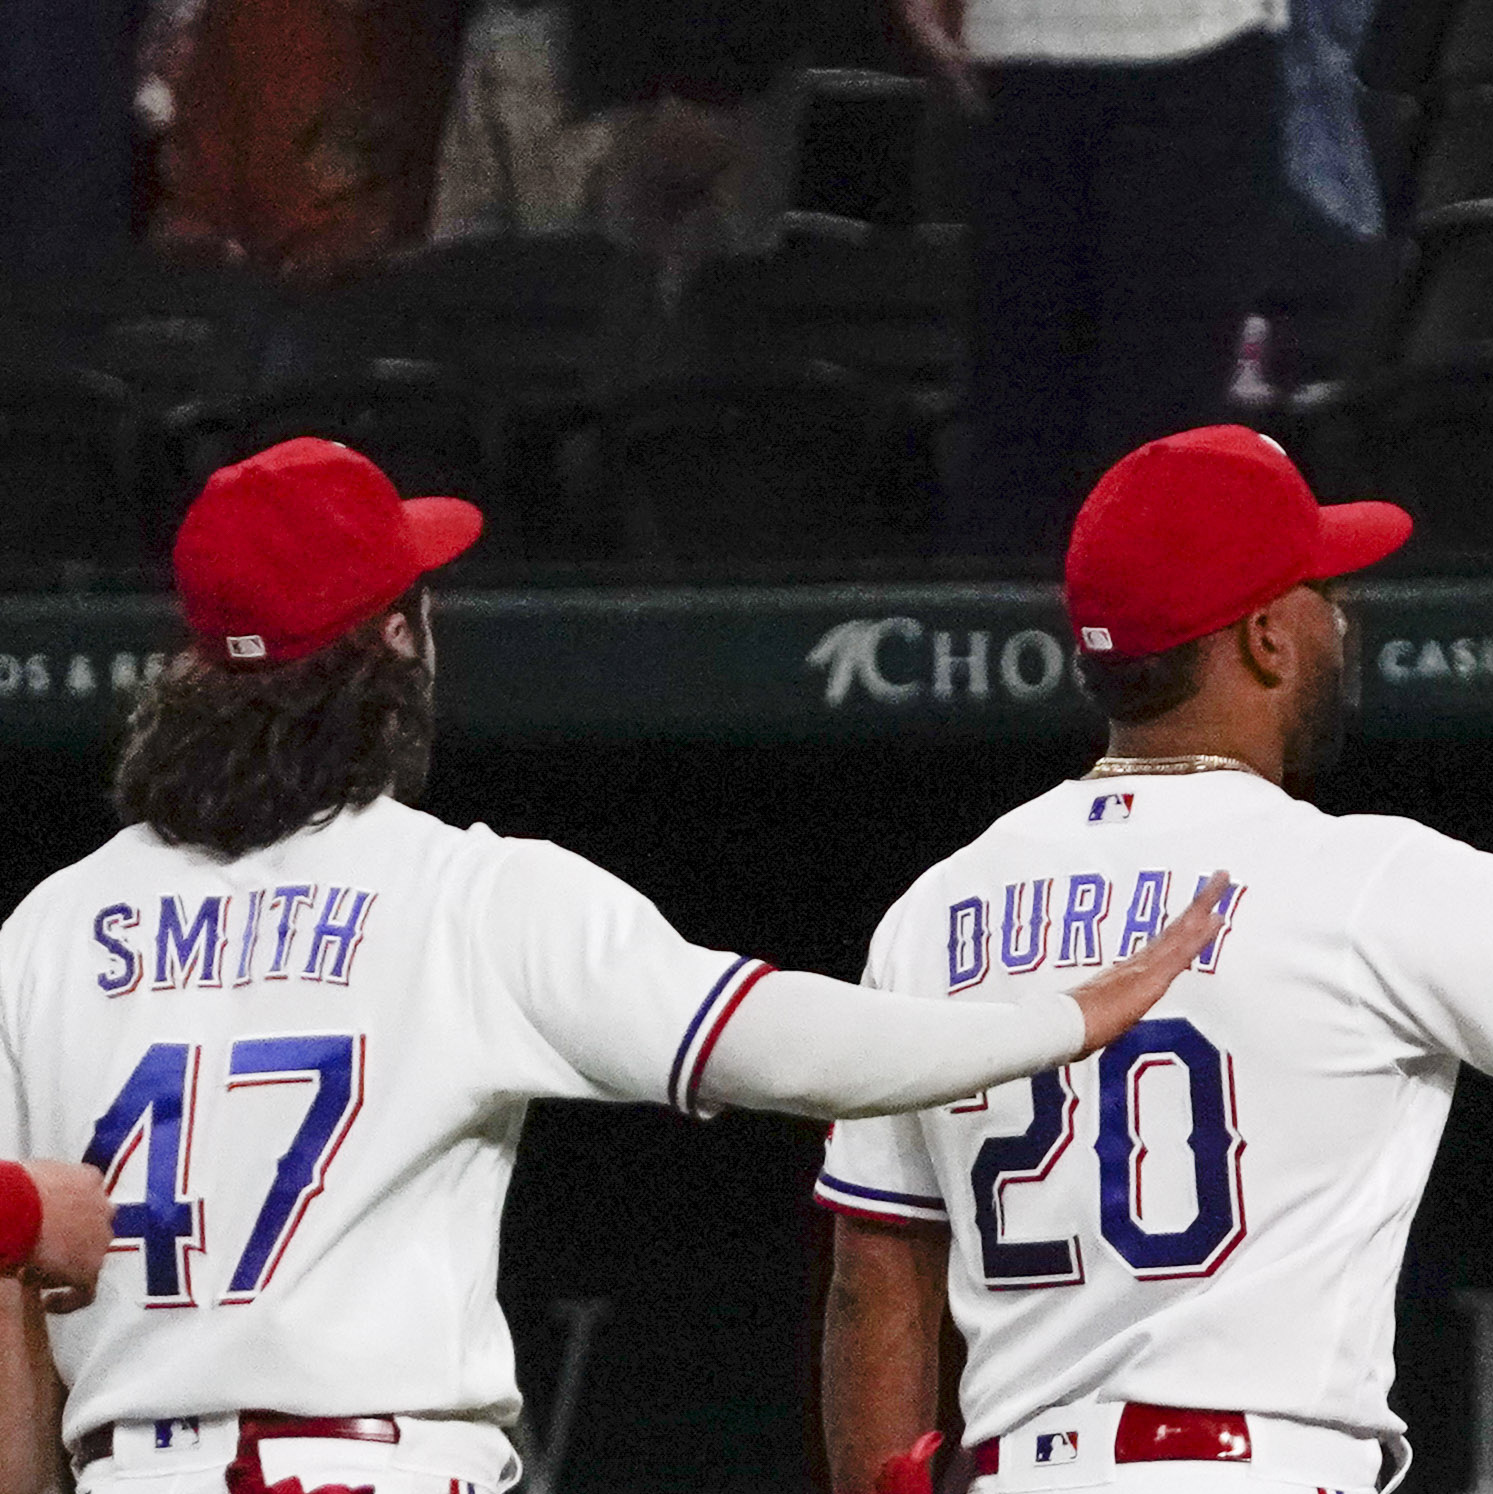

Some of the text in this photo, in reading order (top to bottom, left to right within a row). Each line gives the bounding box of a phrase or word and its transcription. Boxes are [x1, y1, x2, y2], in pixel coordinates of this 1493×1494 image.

[93, 883, 378, 998] SMITH
[82, 1032, 366, 1310] 47
[970, 1016, 1248, 1292] 20
